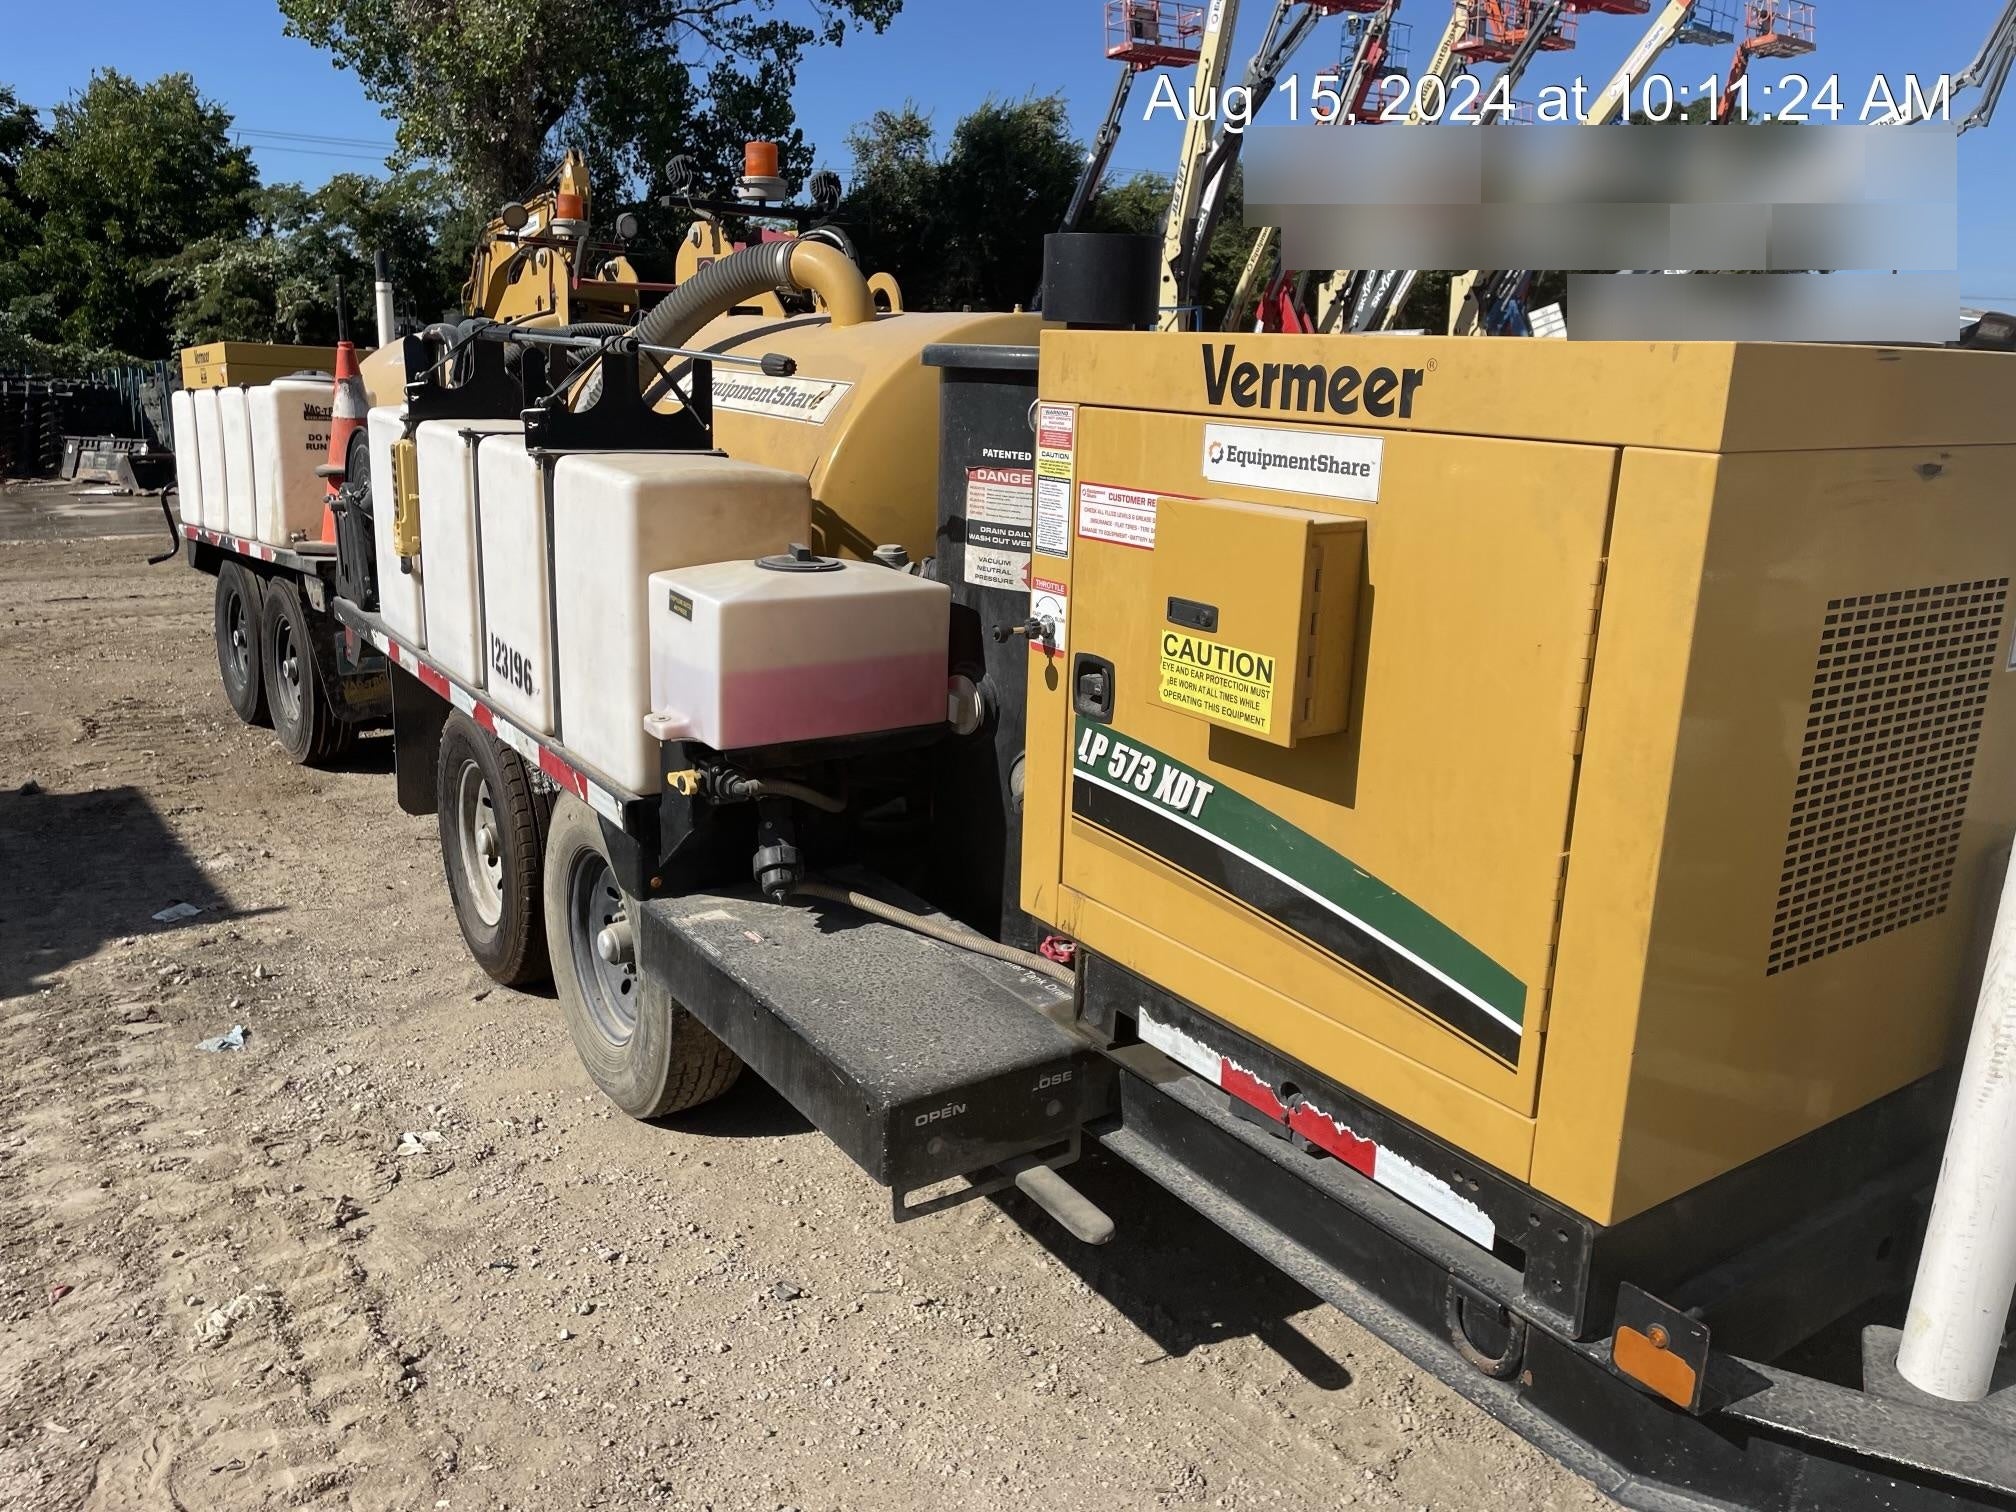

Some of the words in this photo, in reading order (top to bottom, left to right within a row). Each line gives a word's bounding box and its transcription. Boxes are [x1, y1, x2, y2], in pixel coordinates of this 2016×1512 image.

[1202, 343, 1424, 419] Vermeer
[982, 448, 1032, 460] PATENTED
[1041, 451, 1070, 460] CAUTION
[1226, 445, 1371, 477] EquipmentShare
[977, 469, 1033, 484] DANGE
[1109, 493, 1146, 506] CUSTOMER
[969, 533, 991, 542] WASH
[980, 526, 1006, 536] DRAIN
[978, 557, 1011, 566] VACUUM
[977, 565, 1012, 575] NEUTRAL
[975, 574, 1014, 584] PRESSURE
[1036, 579, 1065, 592] THROTTLE
[491, 632, 533, 696] 123196
[1163, 634, 1273, 683] CAUTION
[1162, 661, 1174, 672] EYE
[1176, 665, 1189, 676] AND
[1190, 669, 1204, 680] EAR
[1206, 674, 1248, 692] PROTECTION
[1250, 687, 1270, 699] MUST
[1169, 677, 1177, 686] BE
[1178, 679, 1197, 691] WORN
[1198, 685, 1207, 694] AT
[1206, 687, 1218, 698] ALL
[1220, 691, 1238, 704] TIMES
[1239, 697, 1260, 710] WHILE
[1163, 689, 1202, 707] OPERATING
[1204, 701, 1220, 713] THIS
[1221, 707, 1266, 727] EQUIPMENT
[1078, 727, 1109, 766] LP
[1107, 741, 1157, 792] 573
[1153, 764, 1215, 818] XDT
[915, 1103, 966, 1127] OPEN
